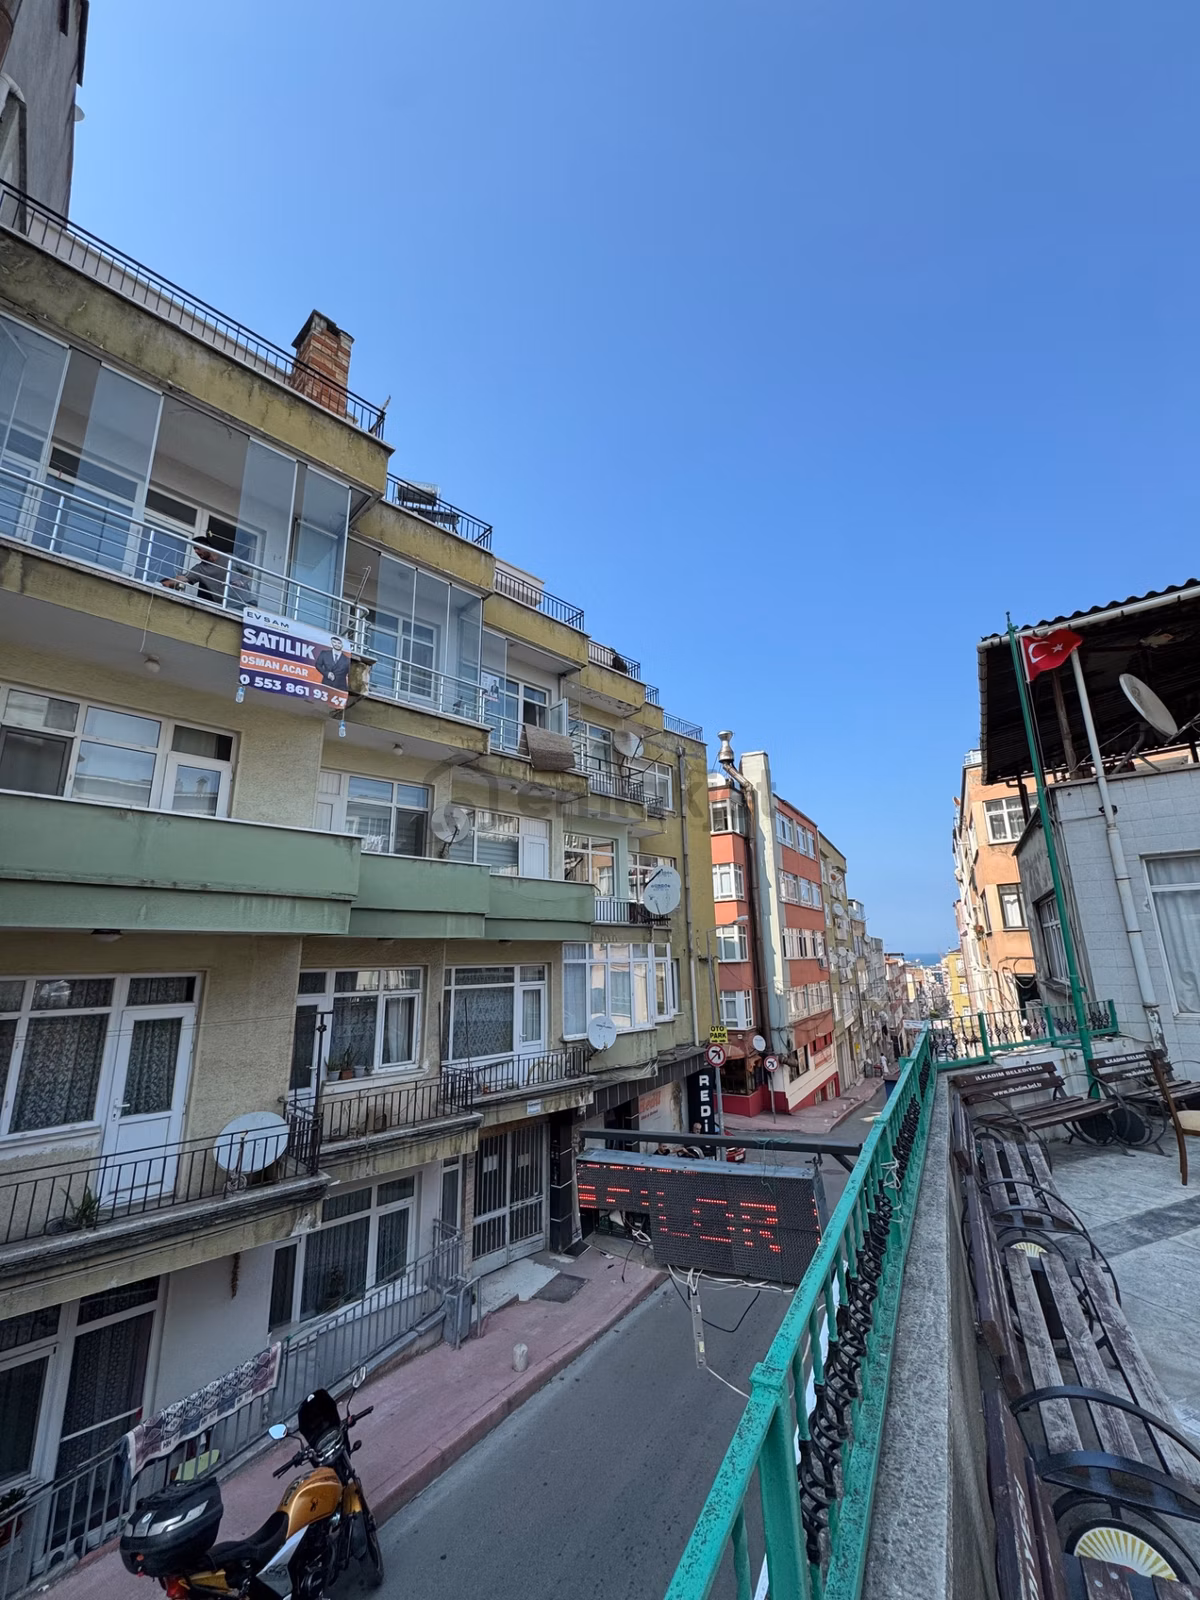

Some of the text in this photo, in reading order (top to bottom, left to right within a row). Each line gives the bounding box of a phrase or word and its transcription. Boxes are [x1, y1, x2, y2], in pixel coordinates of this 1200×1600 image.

[242, 628, 316, 660] SATILIK
[240, 654, 309, 677] OSMAN ACAR
[239, 674, 347, 707] 0 553 861 93 47
[1005, 1065, 1043, 1076] BELEDİYESİ
